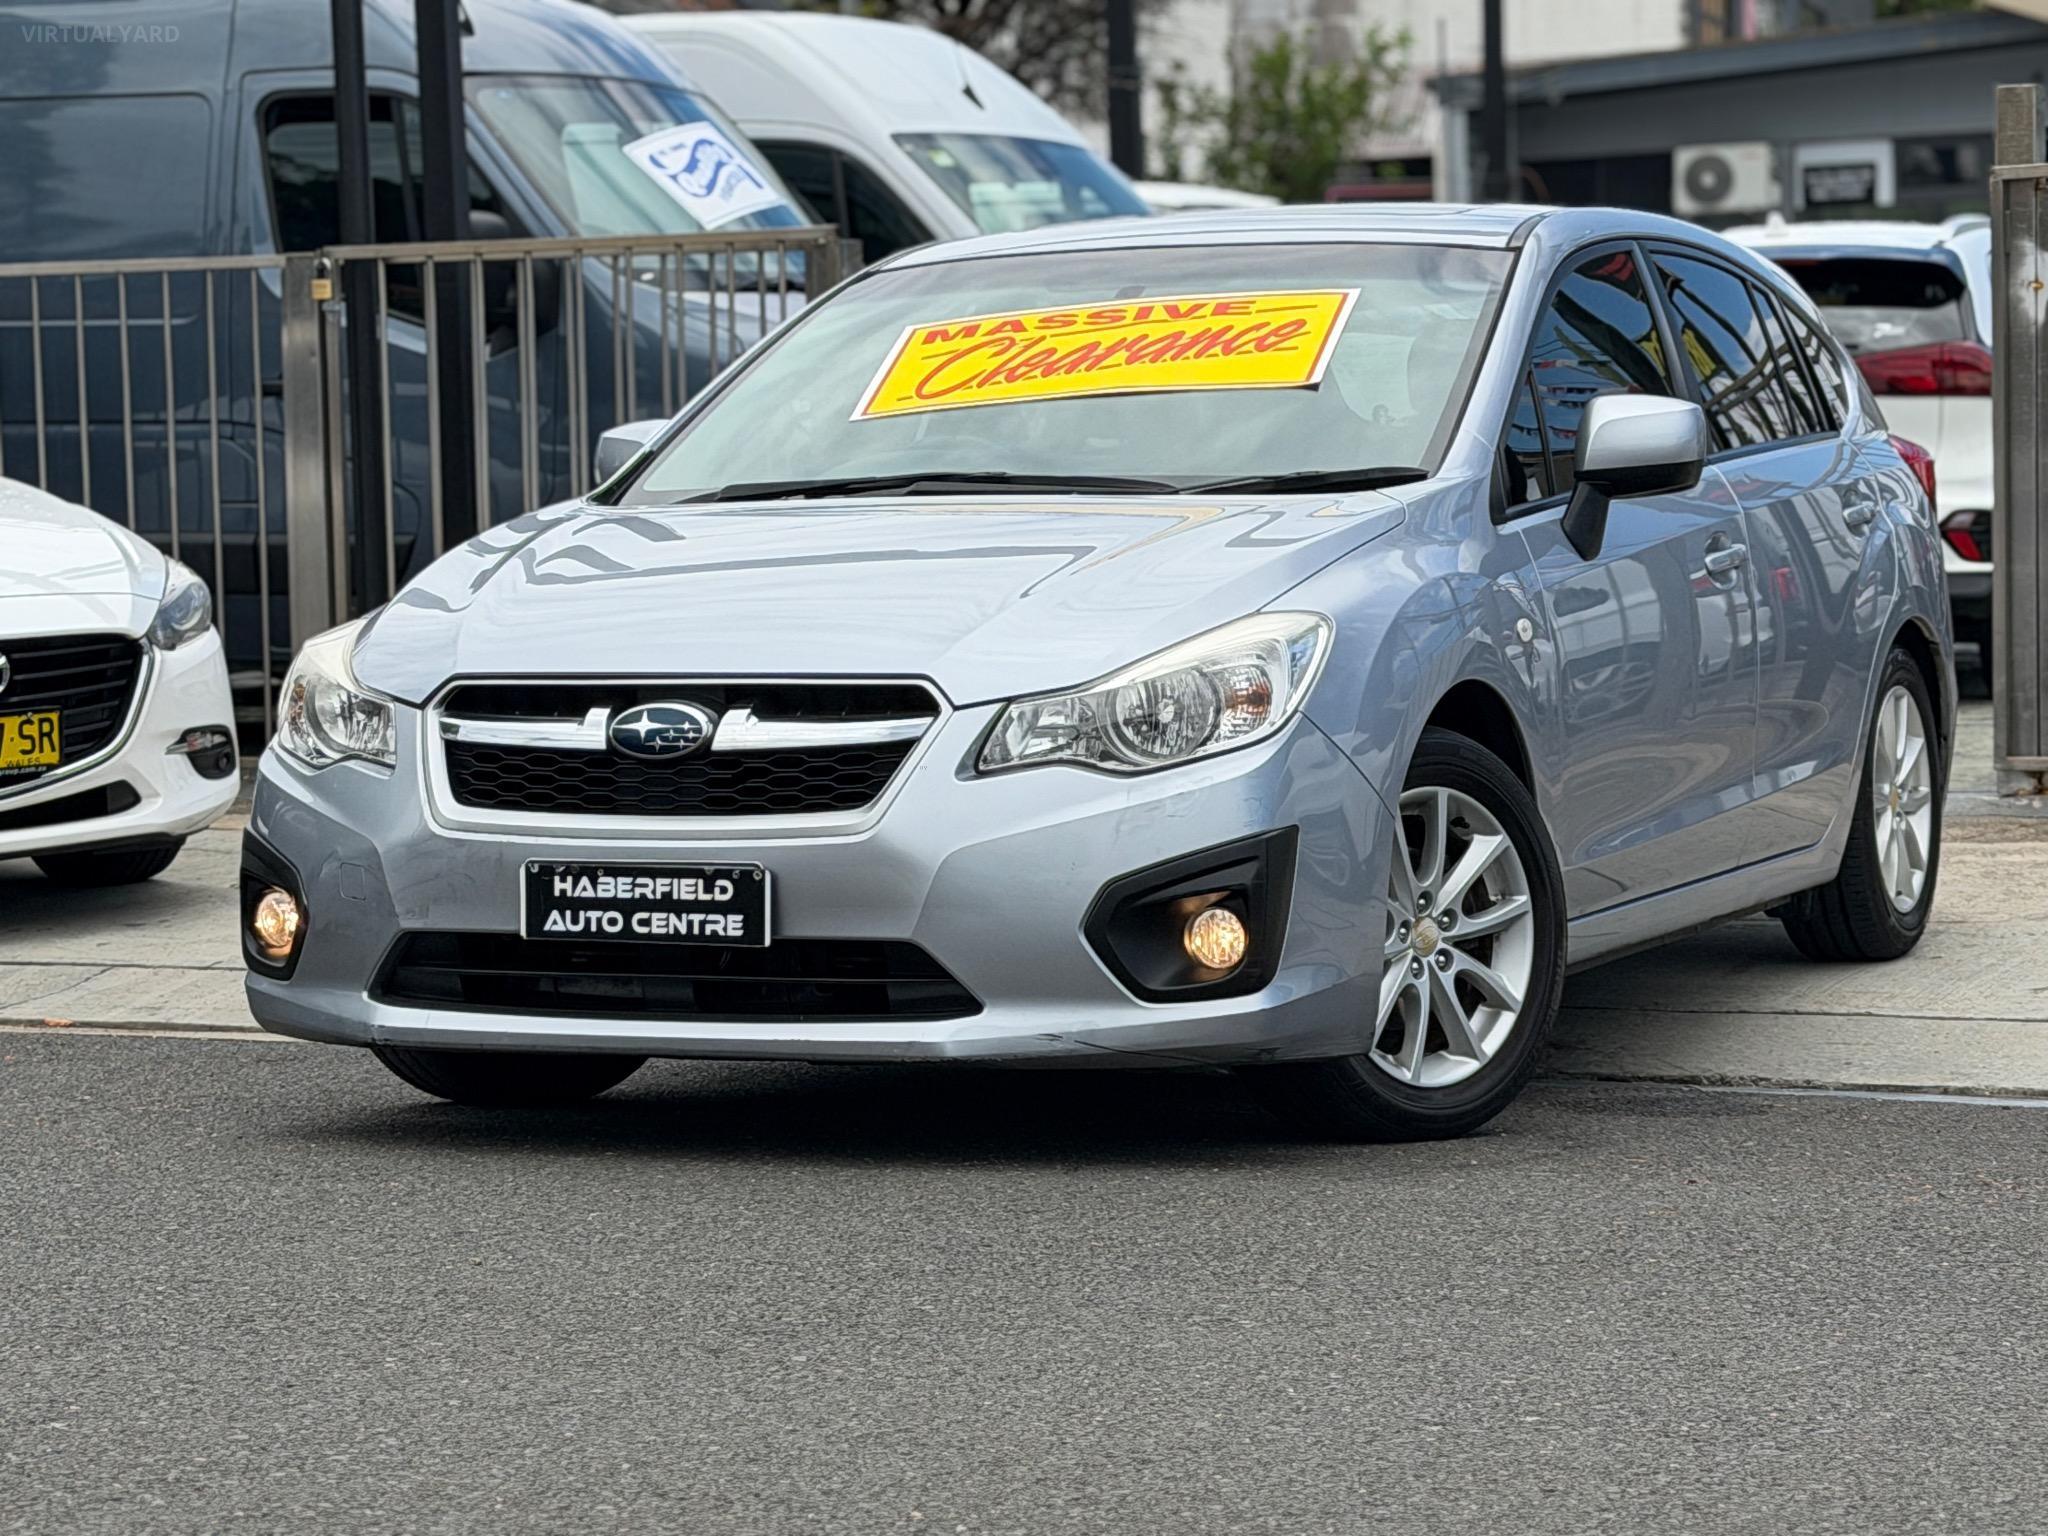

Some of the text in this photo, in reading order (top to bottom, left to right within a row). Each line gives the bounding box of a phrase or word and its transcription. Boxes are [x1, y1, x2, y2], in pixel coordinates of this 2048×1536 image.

[921, 300, 1256, 345] MASSIVE
[915, 318, 1307, 400] Clearance
[553, 875, 734, 901] HABERFIELD
[543, 910, 744, 936] AUTO CENTRE
